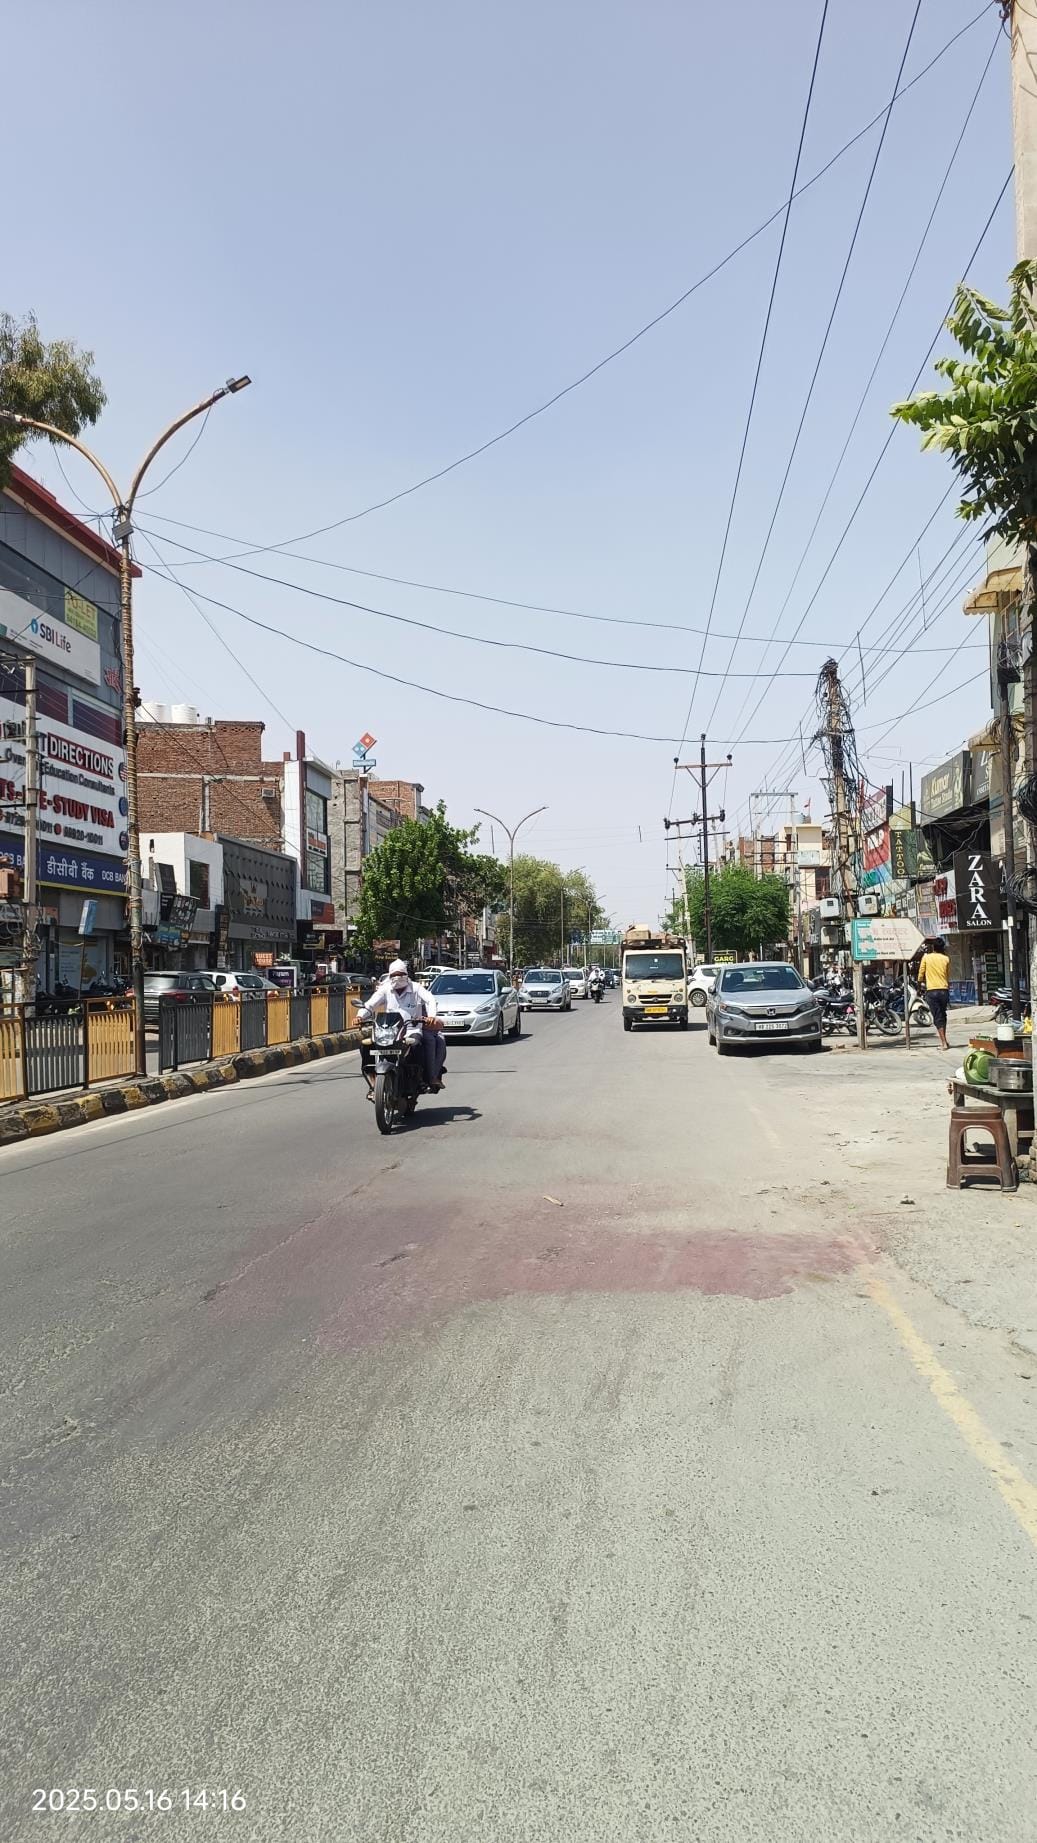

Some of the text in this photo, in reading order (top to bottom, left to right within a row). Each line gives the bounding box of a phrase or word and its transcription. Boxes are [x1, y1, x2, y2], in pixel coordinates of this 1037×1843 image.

[40, 623, 55, 645] SBI
[55, 631, 72, 653] Life
[50, 736, 114, 780] DIRECTIONS
[90, 805, 115, 829] VISA
[895, 831, 905, 875] TATTOO
[968, 855, 988, 919] ZARA
[966, 919, 992, 927] SALON
